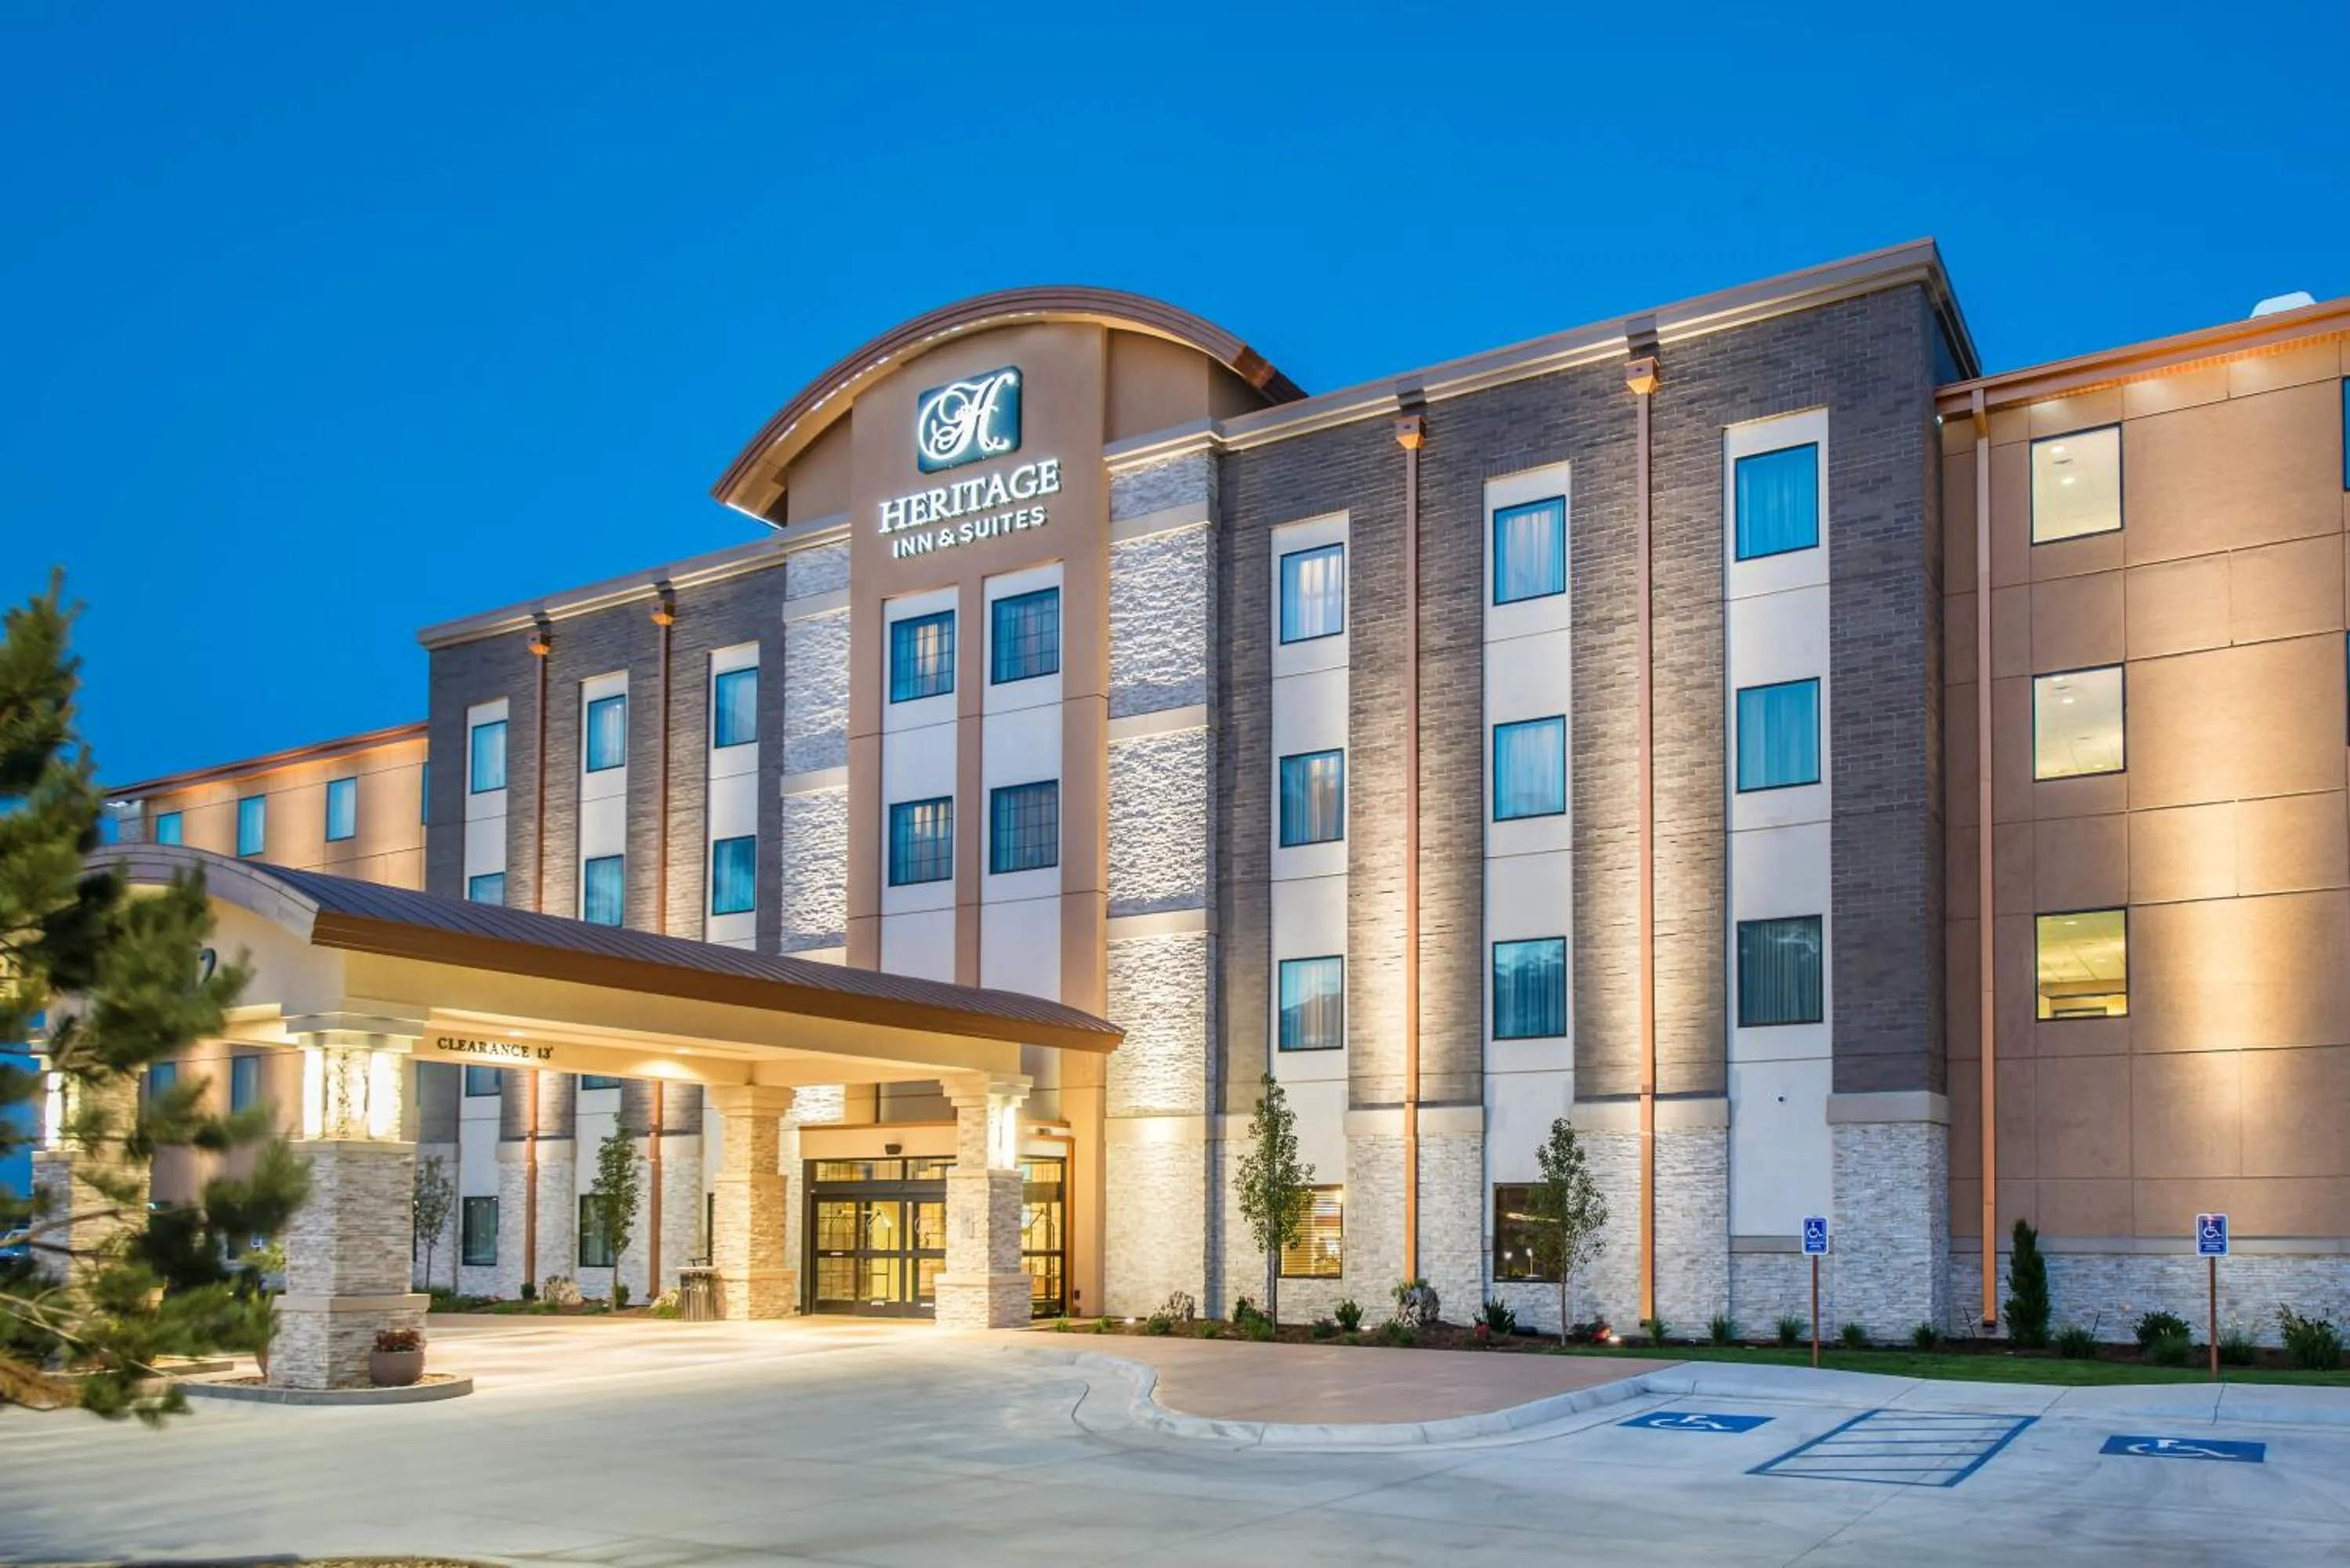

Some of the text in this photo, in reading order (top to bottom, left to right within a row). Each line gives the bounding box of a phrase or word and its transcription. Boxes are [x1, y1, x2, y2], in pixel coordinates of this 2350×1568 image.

[878, 458, 1061, 534] HERITAGE
[892, 506, 1046, 558] INN & SUITES
[436, 1036, 530, 1058] CLEARANCE
